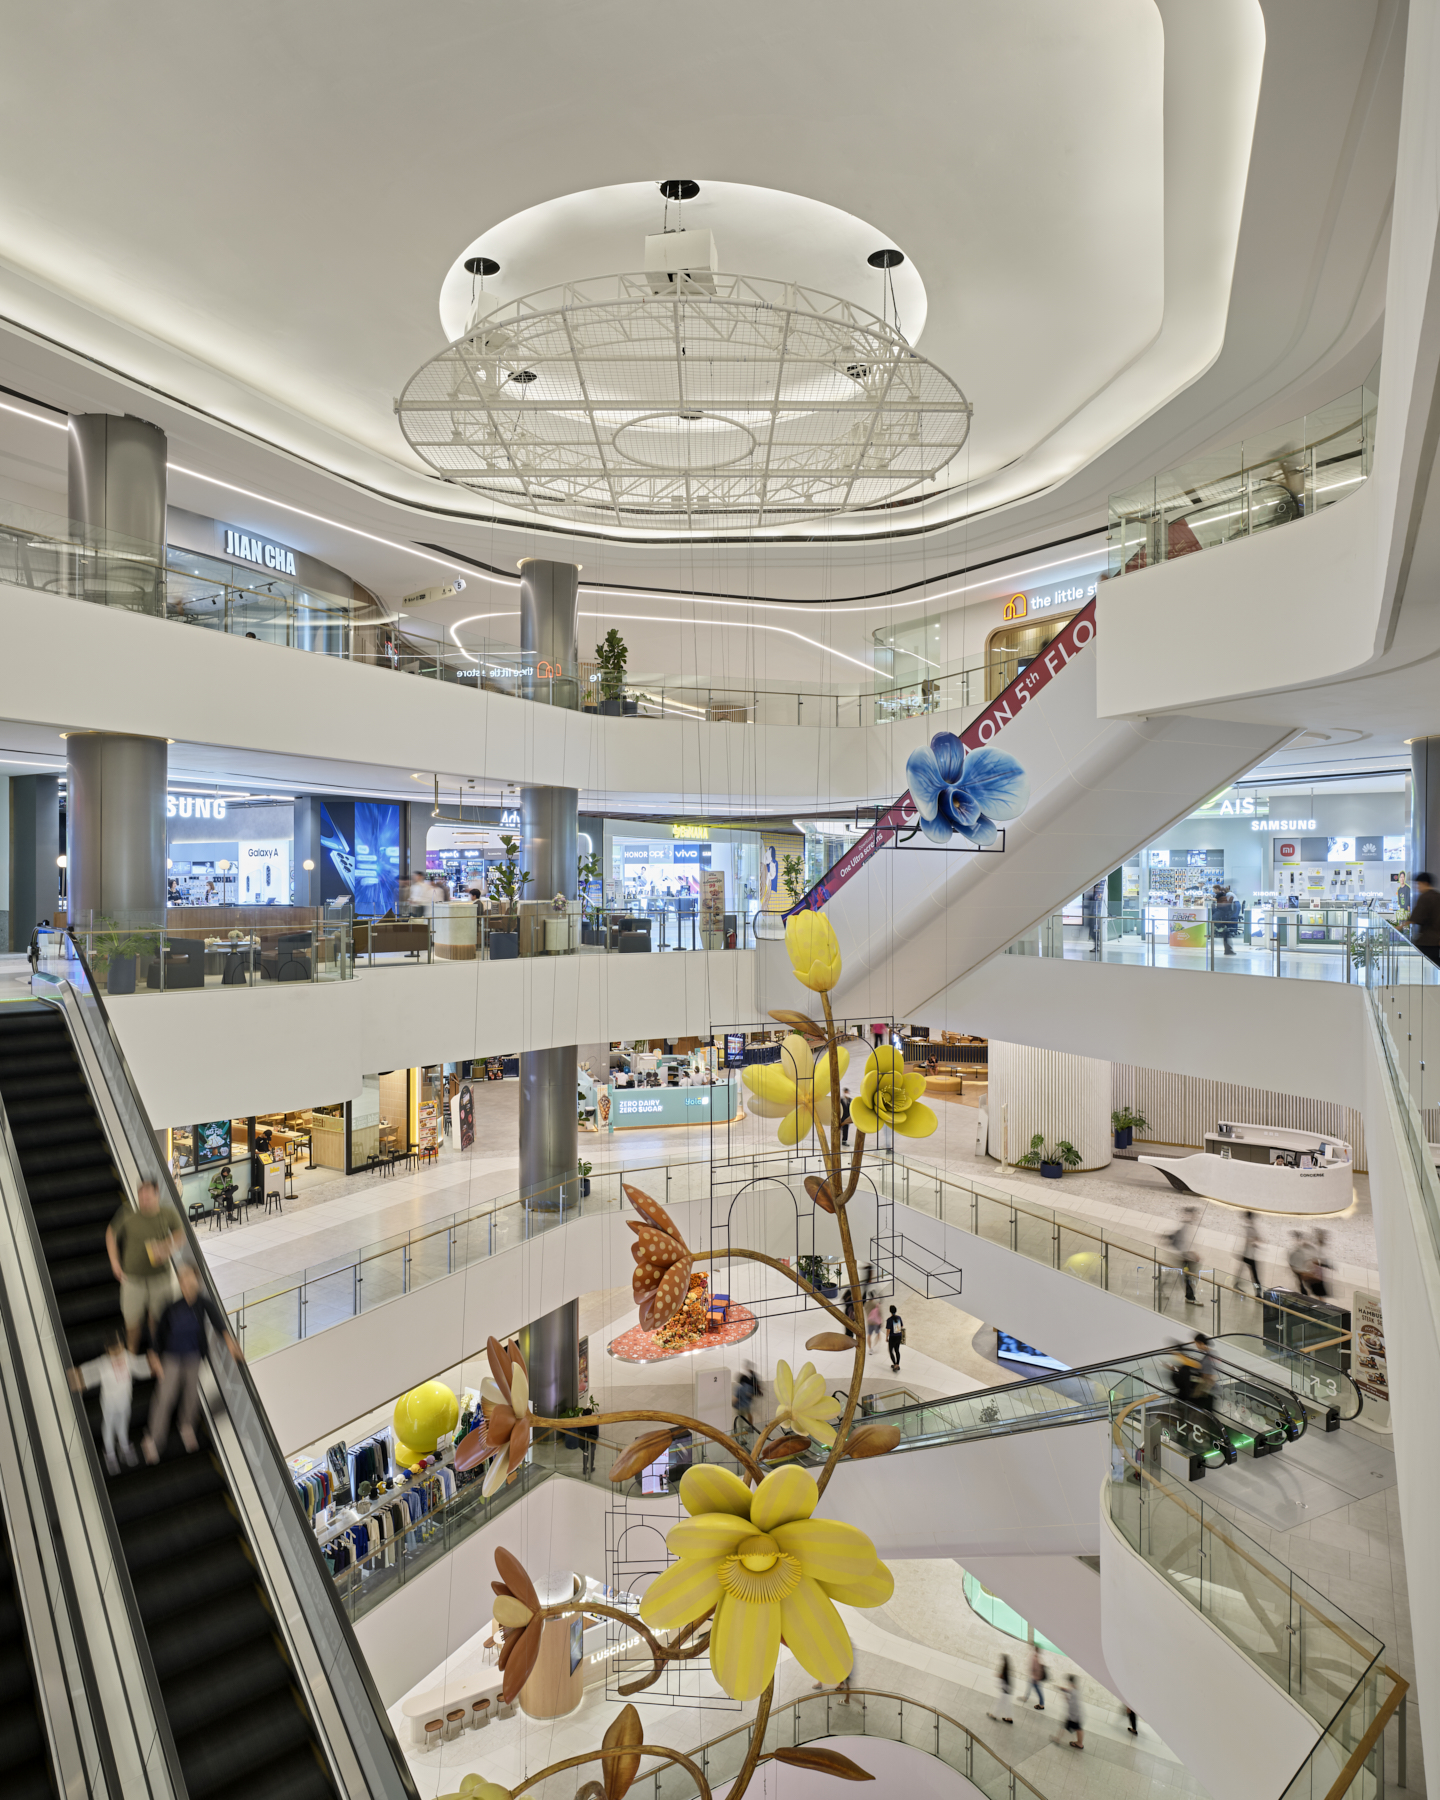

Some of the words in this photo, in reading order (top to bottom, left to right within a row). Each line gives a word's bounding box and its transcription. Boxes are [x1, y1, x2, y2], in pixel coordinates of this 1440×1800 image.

[225, 530, 262, 564] JIAN
[264, 544, 296, 576] CHA
[1031, 596, 1051, 609] the
[1055, 587, 1084, 604] little
[978, 700, 1013, 743] ON
[1014, 671, 1040, 708] 5th
[1044, 610, 1096, 679] FLO
[1220, 798, 1255, 815] AIS
[1251, 820, 1317, 831] SAMSUNG
[248, 848, 274, 859] Galaxy
[273, 848, 279, 857] A
[675, 849, 698, 858] vivo
[840, 863, 852, 878] One
[850, 852, 864, 867] Ultra
[863, 833, 883, 856] screns
[619, 1100, 637, 1108] ZERO
[638, 1099, 660, 1107] DAIRY
[619, 1106, 637, 1114] ZERO
[638, 1105, 663, 1113] SUGAR
[1326, 1379, 1338, 1397] 3
[590, 1636, 640, 1665] LUSCIOUS
